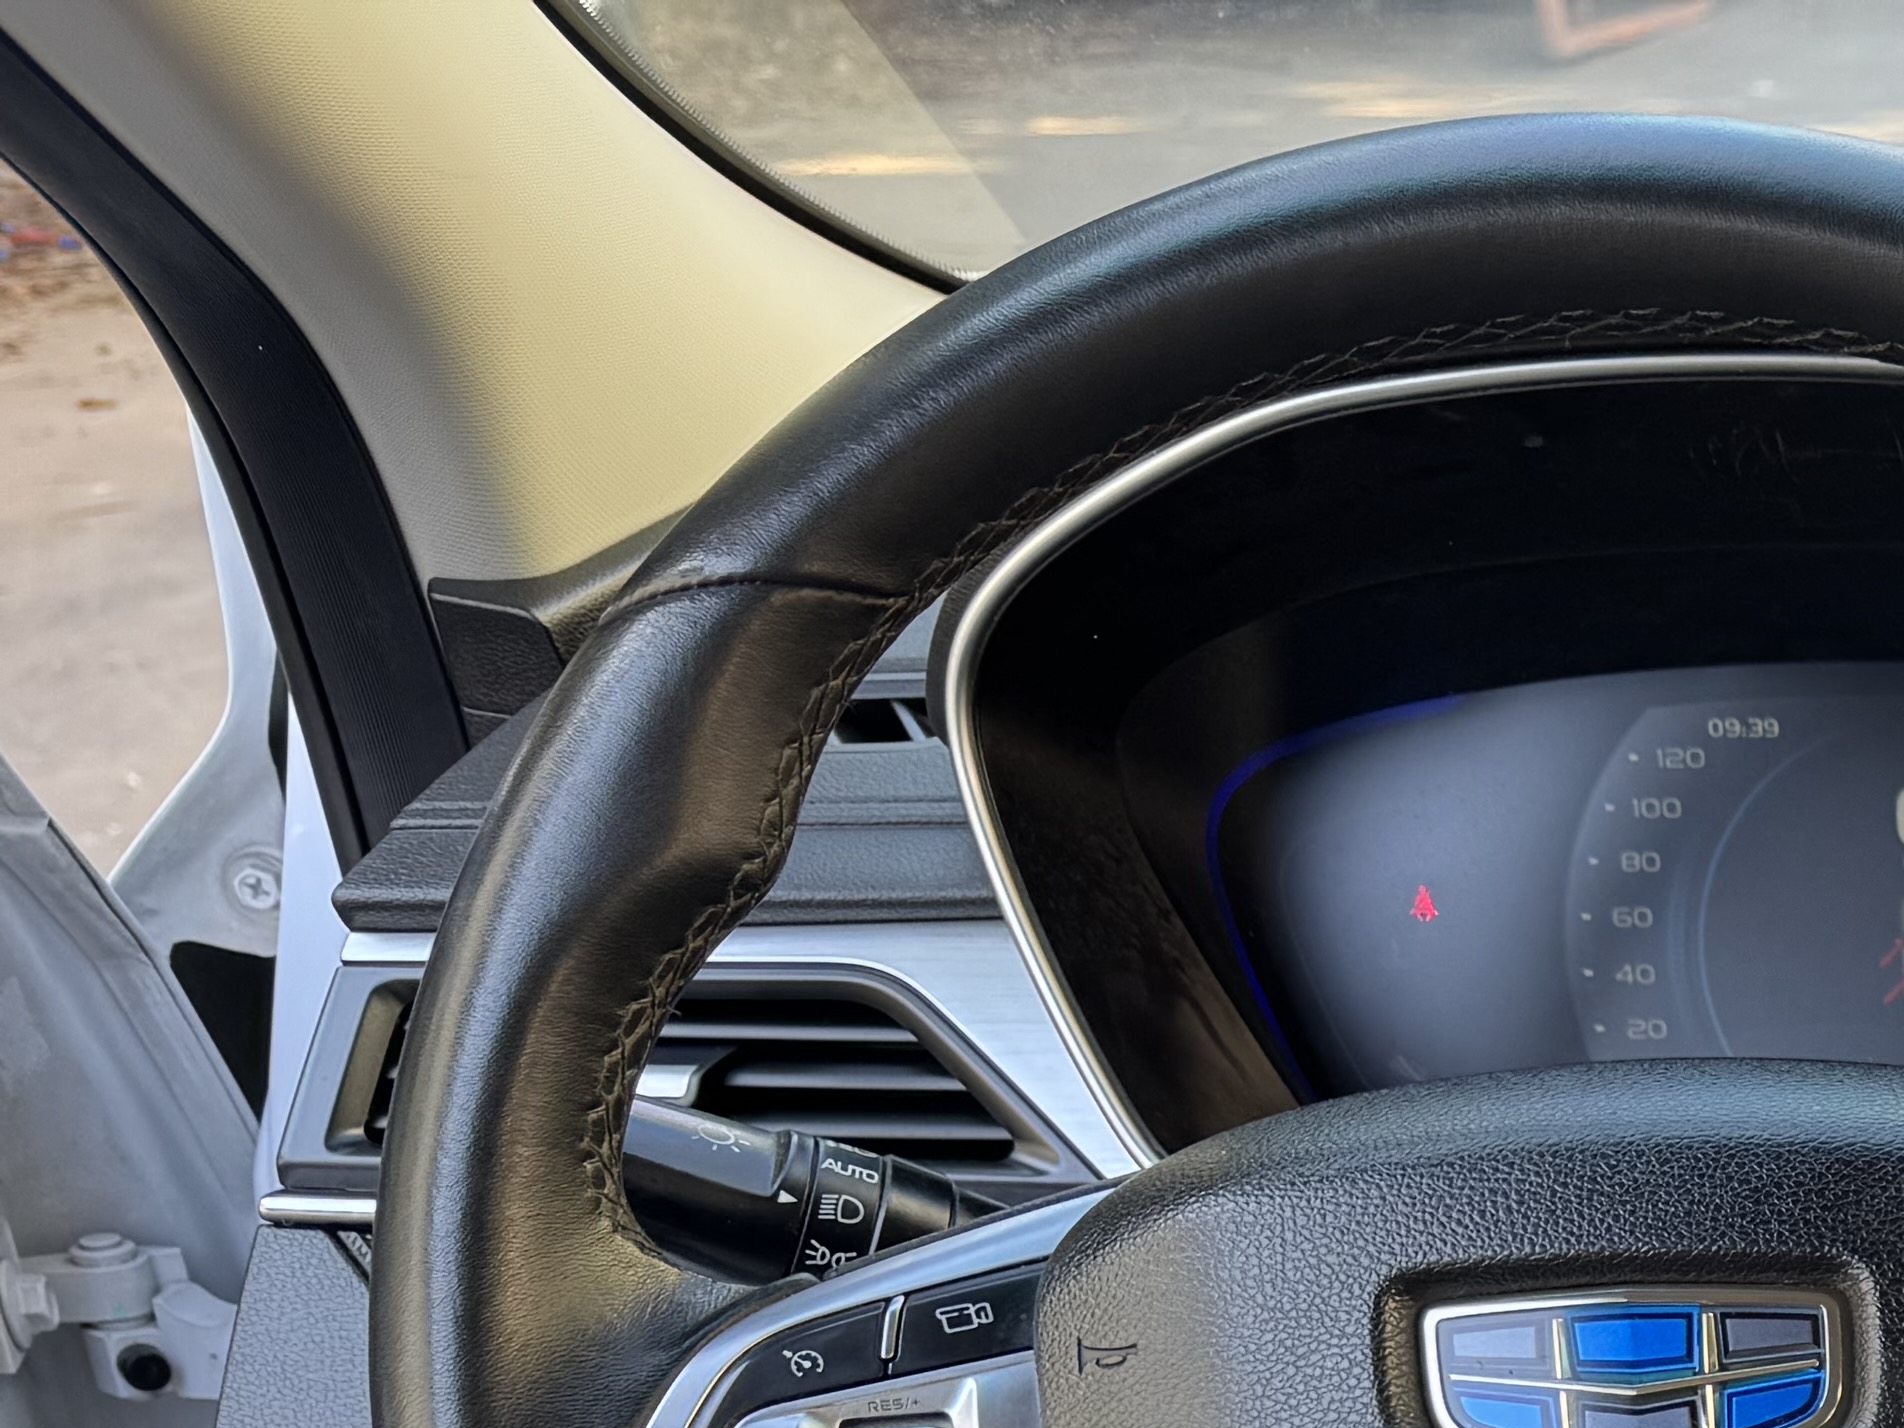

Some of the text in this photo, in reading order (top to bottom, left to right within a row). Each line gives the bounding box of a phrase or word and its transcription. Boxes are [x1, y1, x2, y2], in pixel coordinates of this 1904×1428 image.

[1707, 717, 1780, 741] 09:39
[1655, 747, 1706, 769] 120
[1631, 797, 1682, 820] 100
[1620, 851, 1661, 873] 80
[1612, 906, 1653, 929] 60
[1616, 963, 1656, 985] 40
[1627, 1018, 1667, 1040] 20
[821, 1158, 879, 1184] AUTO
[867, 1398, 919, 1412] RES/+
